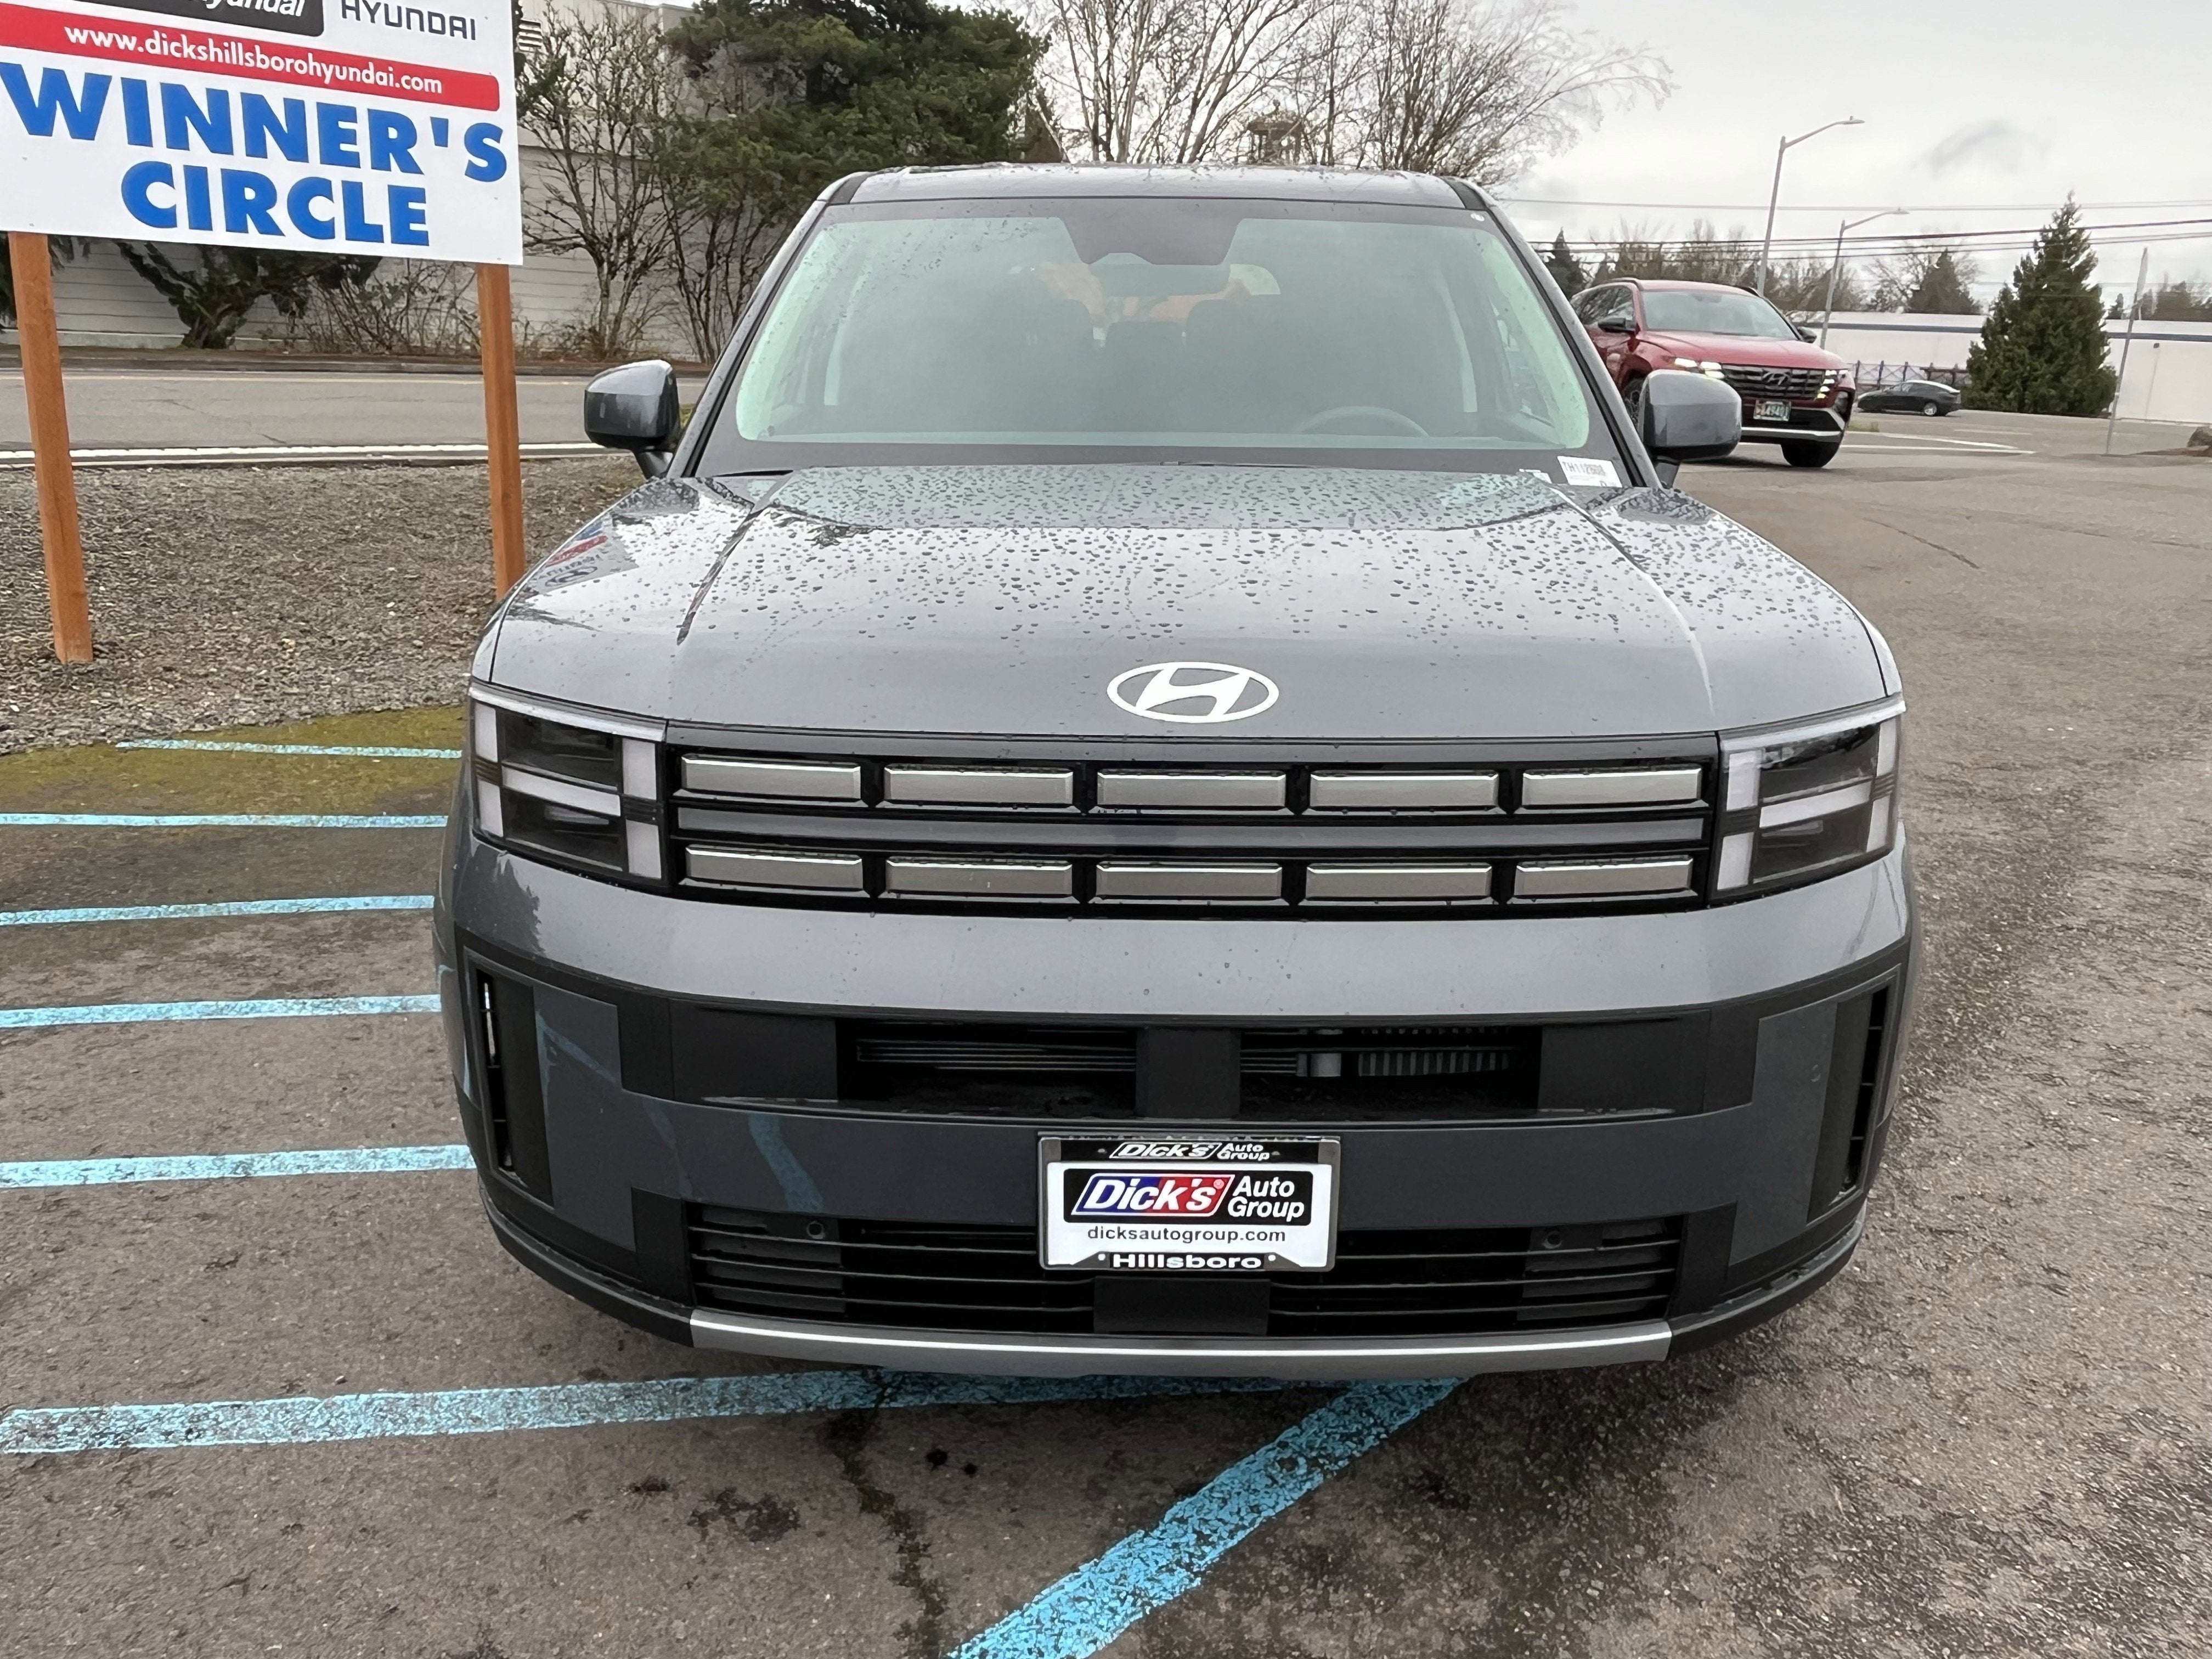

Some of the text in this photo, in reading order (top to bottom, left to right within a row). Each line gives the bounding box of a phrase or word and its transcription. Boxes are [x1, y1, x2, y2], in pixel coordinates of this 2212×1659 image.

[202, 0, 306, 16] ndai
[341, 0, 476, 41] HYUNDAI
[64, 25, 442, 94] www.dickshillsborohyundai.com
[0, 63, 506, 182] WINNER'S
[122, 161, 429, 246] CIRCLE
[1118, 1143, 1211, 1157] Dick's
[1216, 1152, 1270, 1161] Group
[1221, 1143, 1264, 1152] Auto
[1084, 1177, 1216, 1211] Dick's
[1233, 1175, 1295, 1197] Auto
[1227, 1196, 1305, 1222] Group
[1087, 1226, 1285, 1244] dicksautogroup.com
[1113, 1254, 1262, 1268] Hillsboro
